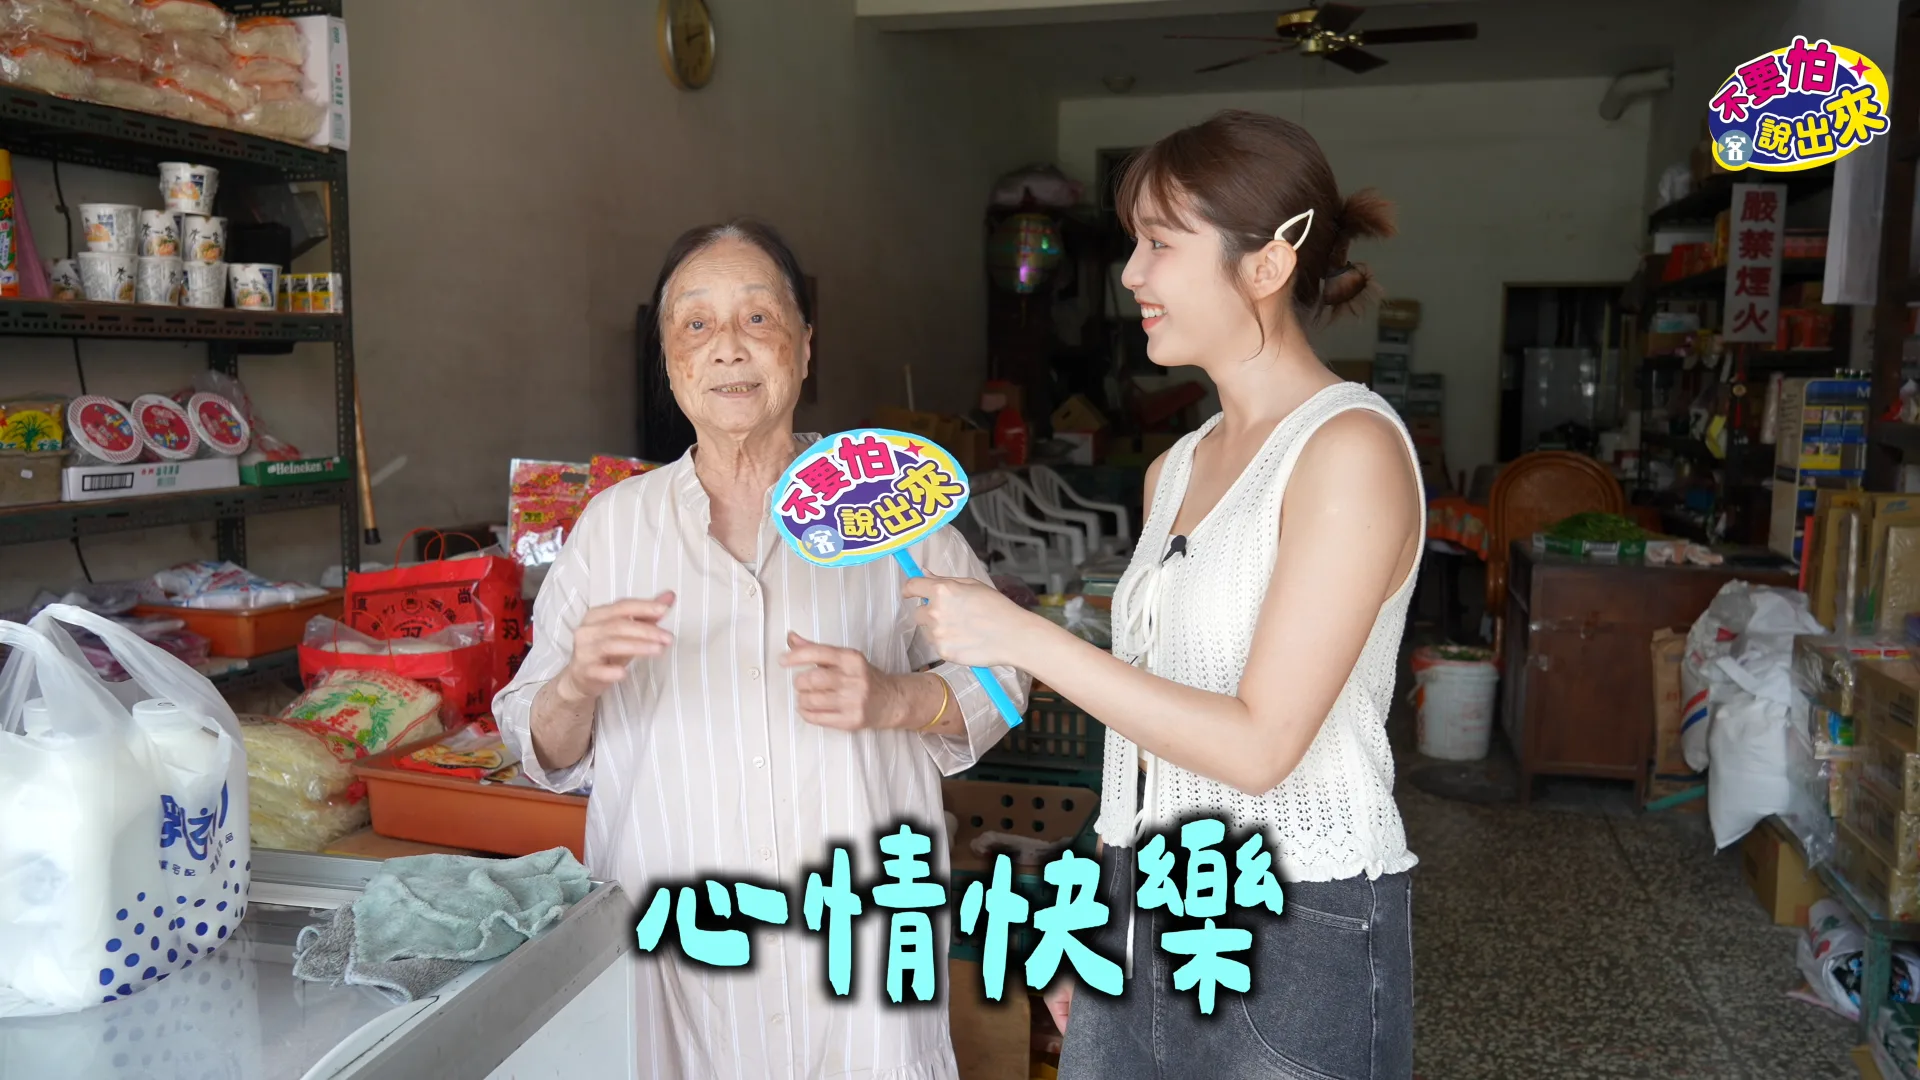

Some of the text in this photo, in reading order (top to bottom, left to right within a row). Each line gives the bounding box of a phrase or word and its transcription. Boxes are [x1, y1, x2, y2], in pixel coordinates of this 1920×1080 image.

[1732, 190, 1779, 335] 嚴禁煙火
[276, 461, 322, 475] Heineken
[781, 436, 896, 520] 不要怕
[839, 460, 964, 538] 說出來
